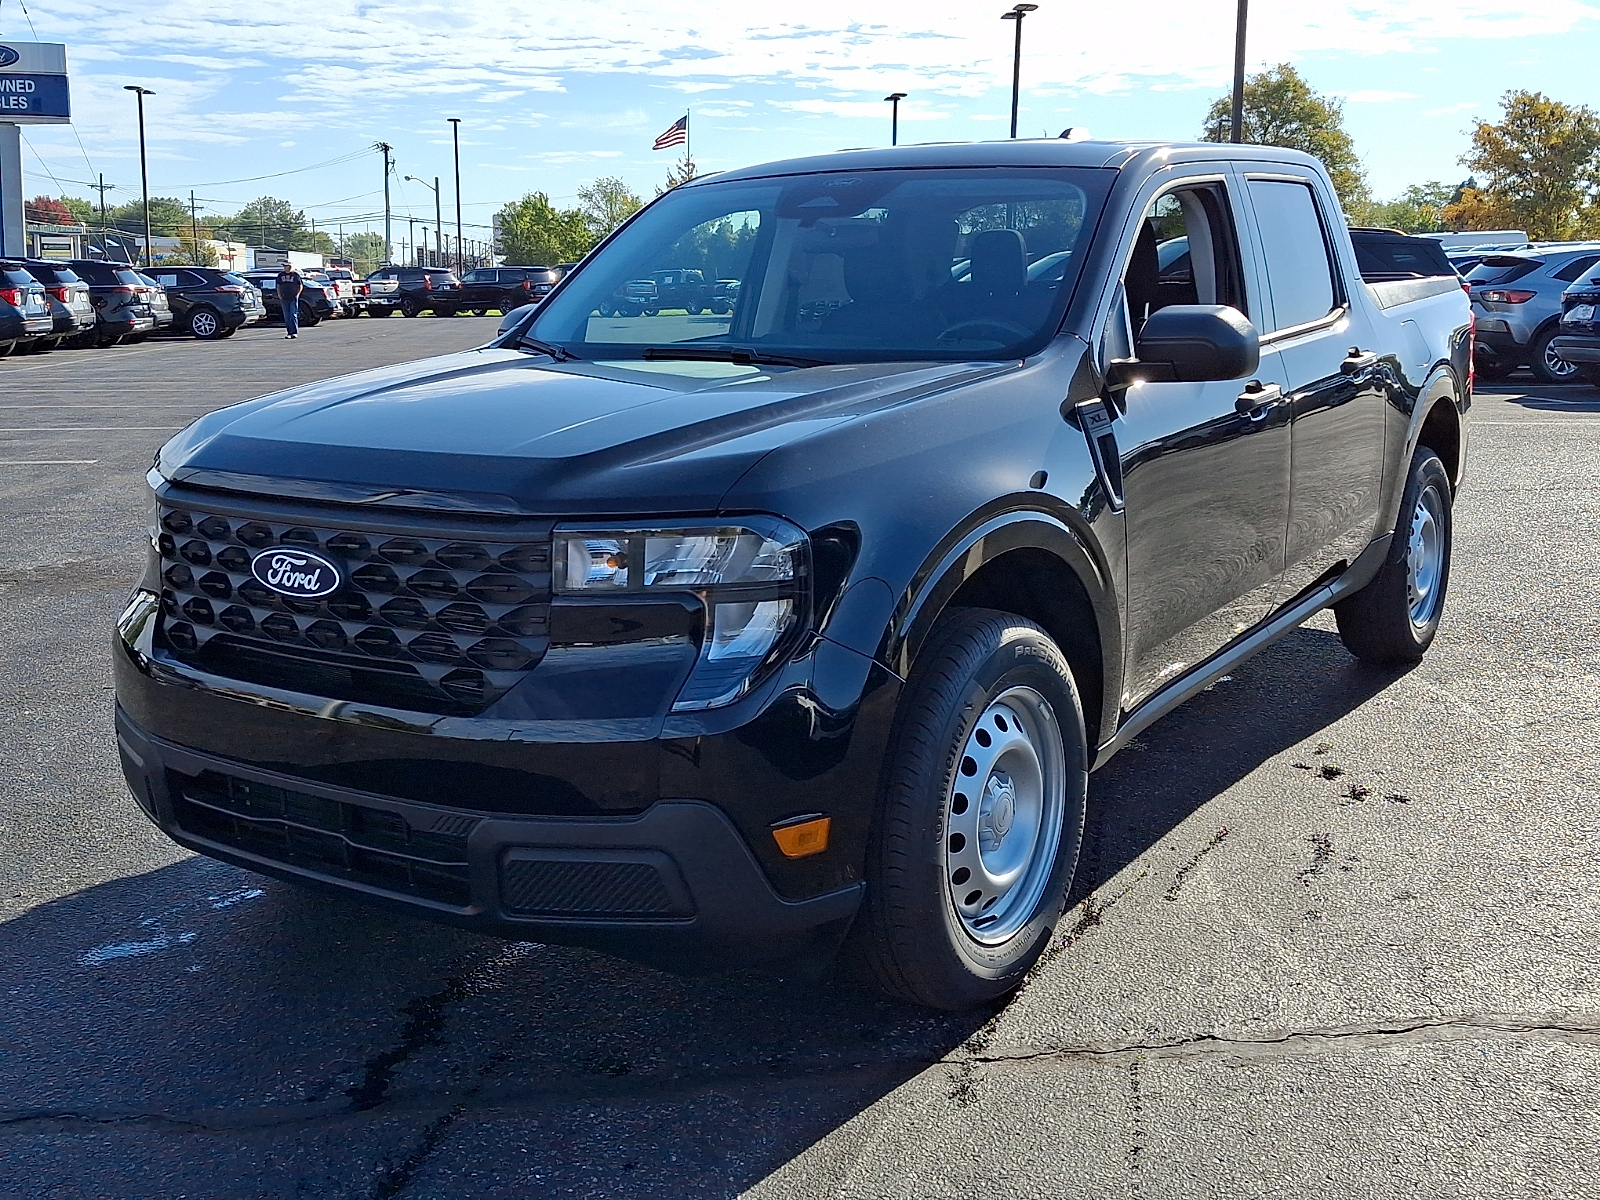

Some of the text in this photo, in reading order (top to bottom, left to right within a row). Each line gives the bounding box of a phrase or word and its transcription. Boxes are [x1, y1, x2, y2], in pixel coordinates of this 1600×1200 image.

[0, 95, 28, 110] LES
[1089, 413, 1107, 425] XL
[267, 554, 321, 591] Ford
